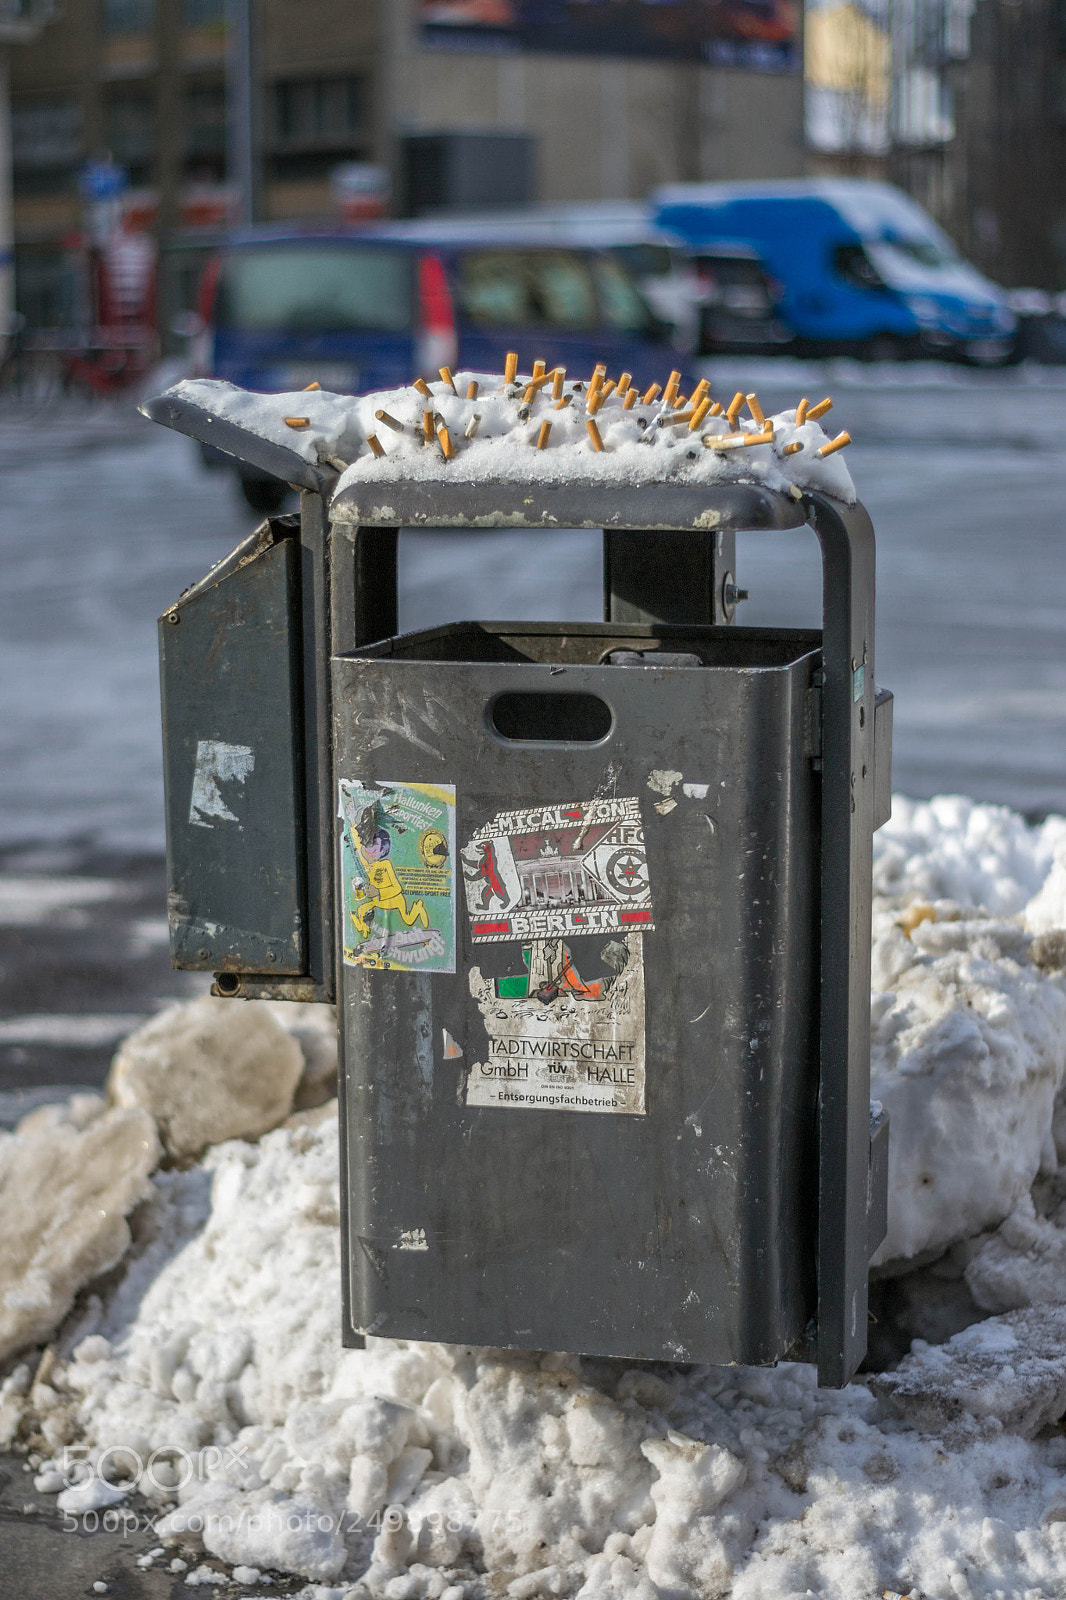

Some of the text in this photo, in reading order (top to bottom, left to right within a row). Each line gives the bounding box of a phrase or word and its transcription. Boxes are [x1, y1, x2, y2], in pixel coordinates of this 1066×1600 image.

[393, 793, 443, 819] Hallunken
[474, 811, 569, 836] EMICAL
[511, 911, 619, 934] BERLIN
[491, 1039, 635, 1061] TADTWIRTSCHAFT
[480, 1060, 529, 1078] GmbH
[547, 1061, 568, 1074] TÜV
[587, 1066, 636, 1084] HALLE
[498, 1091, 618, 1107] Entsorgungsfachbetrieb
